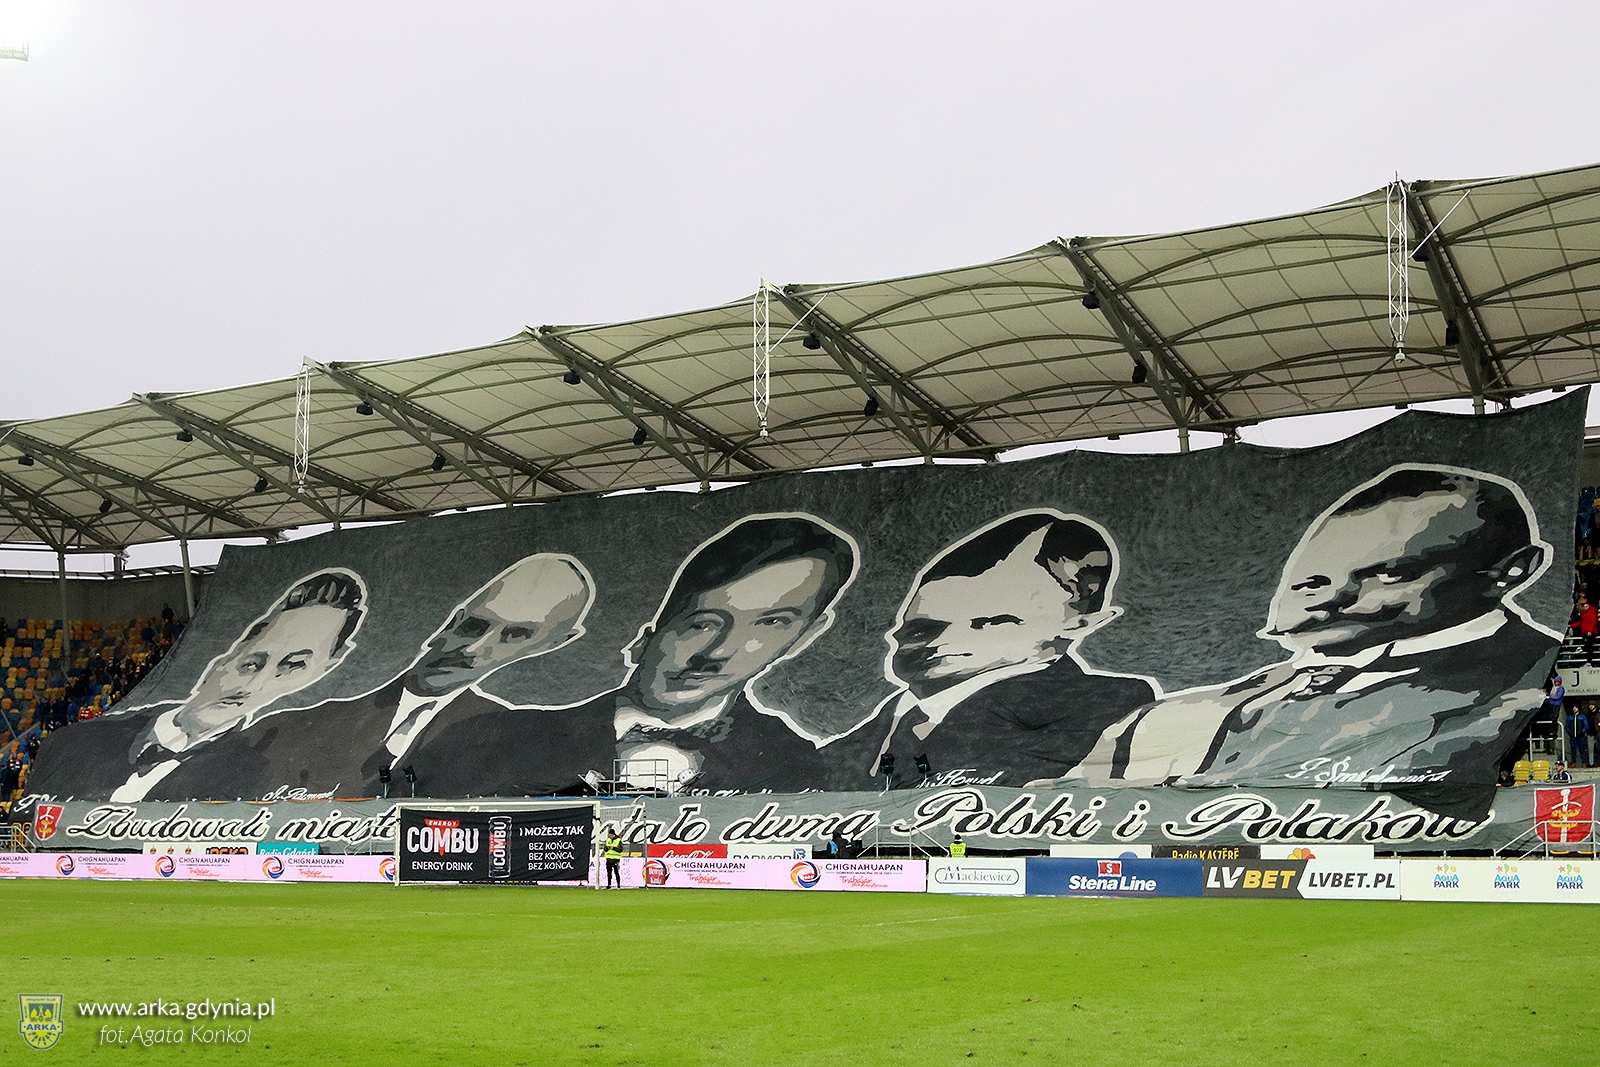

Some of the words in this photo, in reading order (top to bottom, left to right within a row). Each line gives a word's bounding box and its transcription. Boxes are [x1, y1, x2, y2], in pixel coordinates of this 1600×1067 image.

[1571, 670, 1580, 687] J
[66, 804, 273, 842] Zbudowali
[890, 788, 1107, 841] Polski
[1112, 800, 1151, 841] i
[524, 825, 563, 837] MOŻESZ
[564, 825, 585, 835] TAK
[406, 826, 480, 854] COMBU
[493, 821, 507, 867] COMBU
[528, 842, 544, 851] BEZ
[528, 852, 544, 860] BEZ
[411, 861, 445, 870] ENERGY
[446, 862, 473, 871] DRINK
[528, 862, 543, 871] BEZ
[674, 861, 745, 869] CHIGNAHUAPAN
[825, 863, 903, 871] CHIGNAHUAPAN
[1106, 863, 1113, 874] S
[944, 866, 1012, 882] Mackiewicz
[1308, 872, 1396, 889] LVBET.PL
[1433, 881, 1460, 889] PARK
[1556, 882, 1584, 890] PARK
